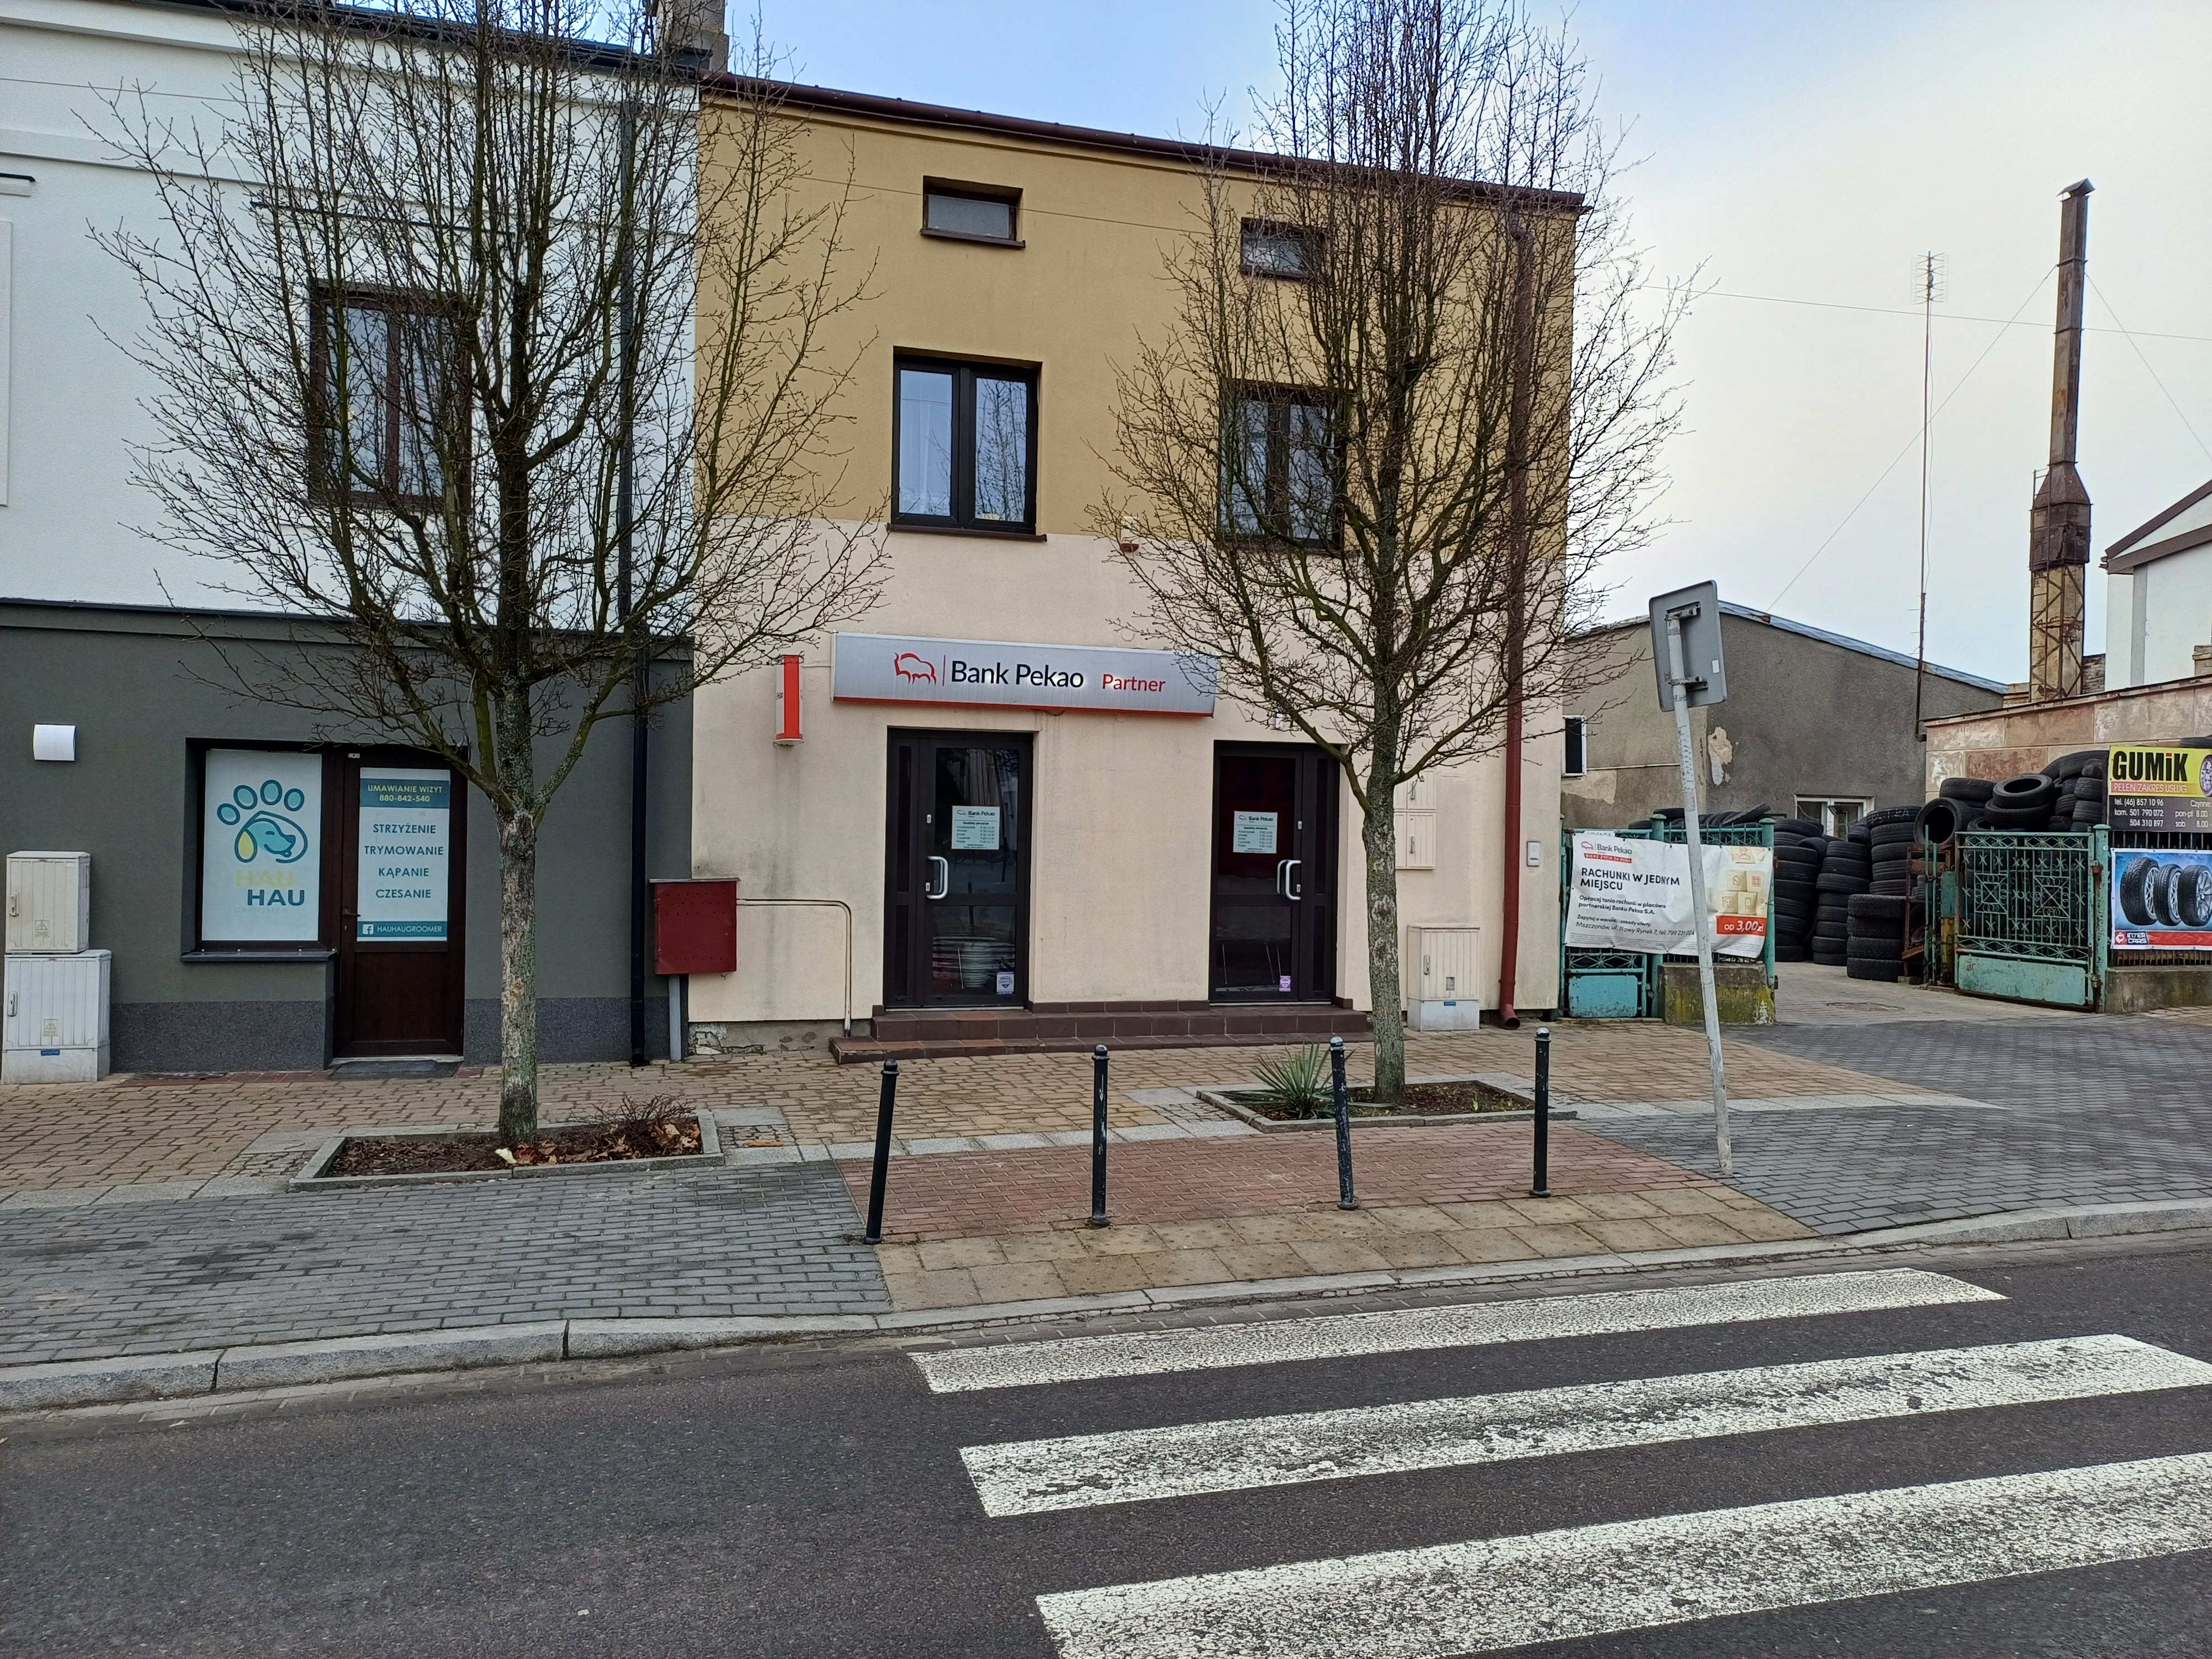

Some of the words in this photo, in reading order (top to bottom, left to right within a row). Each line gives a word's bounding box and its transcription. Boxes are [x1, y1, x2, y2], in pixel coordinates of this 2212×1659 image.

[951, 660, 1010, 685] Bank
[1016, 664, 1084, 688] Pekao
[1102, 674, 1166, 692] Partner
[2112, 751, 2188, 781] GUMiK
[2114, 782, 2135, 791] PEŁEN
[2137, 784, 2163, 792] ZAKRES
[2165, 784, 2187, 793] USŁUG
[379, 794, 430, 802] 880-842-540
[2124, 798, 2135, 807] (46)
[373, 823, 436, 833] STRZYŻENIE
[364, 846, 444, 855] TRYMOWANIE
[1597, 843, 1613, 852] Bank
[1614, 846, 1632, 854] Pekao
[378, 868, 429, 878] KĄPANIE
[1582, 868, 1630, 881] RACHUNKI
[1644, 874, 1680, 885] JEDNYM
[236, 870, 294, 887] HAU
[1580, 878, 1623, 891] MIEJSCU
[247, 889, 305, 906] HAU
[375, 889, 431, 898] CZESANIE
[1579, 895, 1601, 903] Opłacaj
[1578, 902, 1611, 911] partnerskiej
[1575, 922, 1610, 931] Mszczonów,
